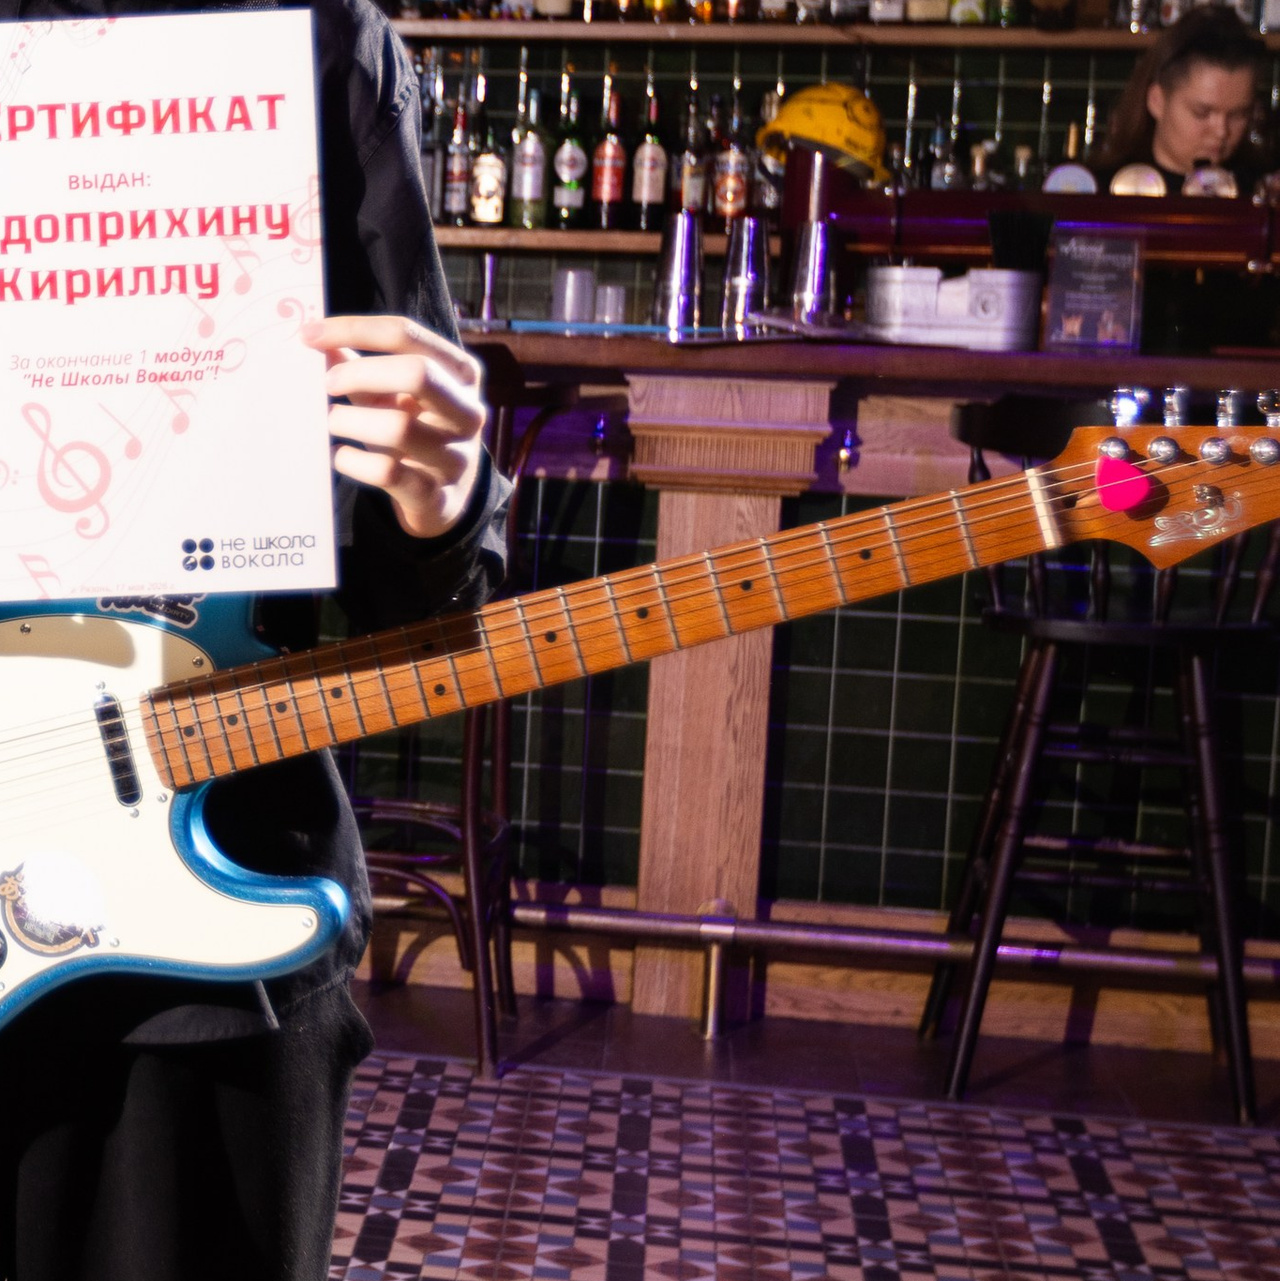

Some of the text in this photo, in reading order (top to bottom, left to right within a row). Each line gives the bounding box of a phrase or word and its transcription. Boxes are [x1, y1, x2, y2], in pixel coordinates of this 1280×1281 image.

[68, 172, 152, 193] ВЫДАН:
[10, 347, 225, 370] За окончание 1 модуля
[23, 365, 220, 388] "Не Школы Вокала"!
[221, 535, 316, 551] не школа
[222, 552, 304, 569] вокала
